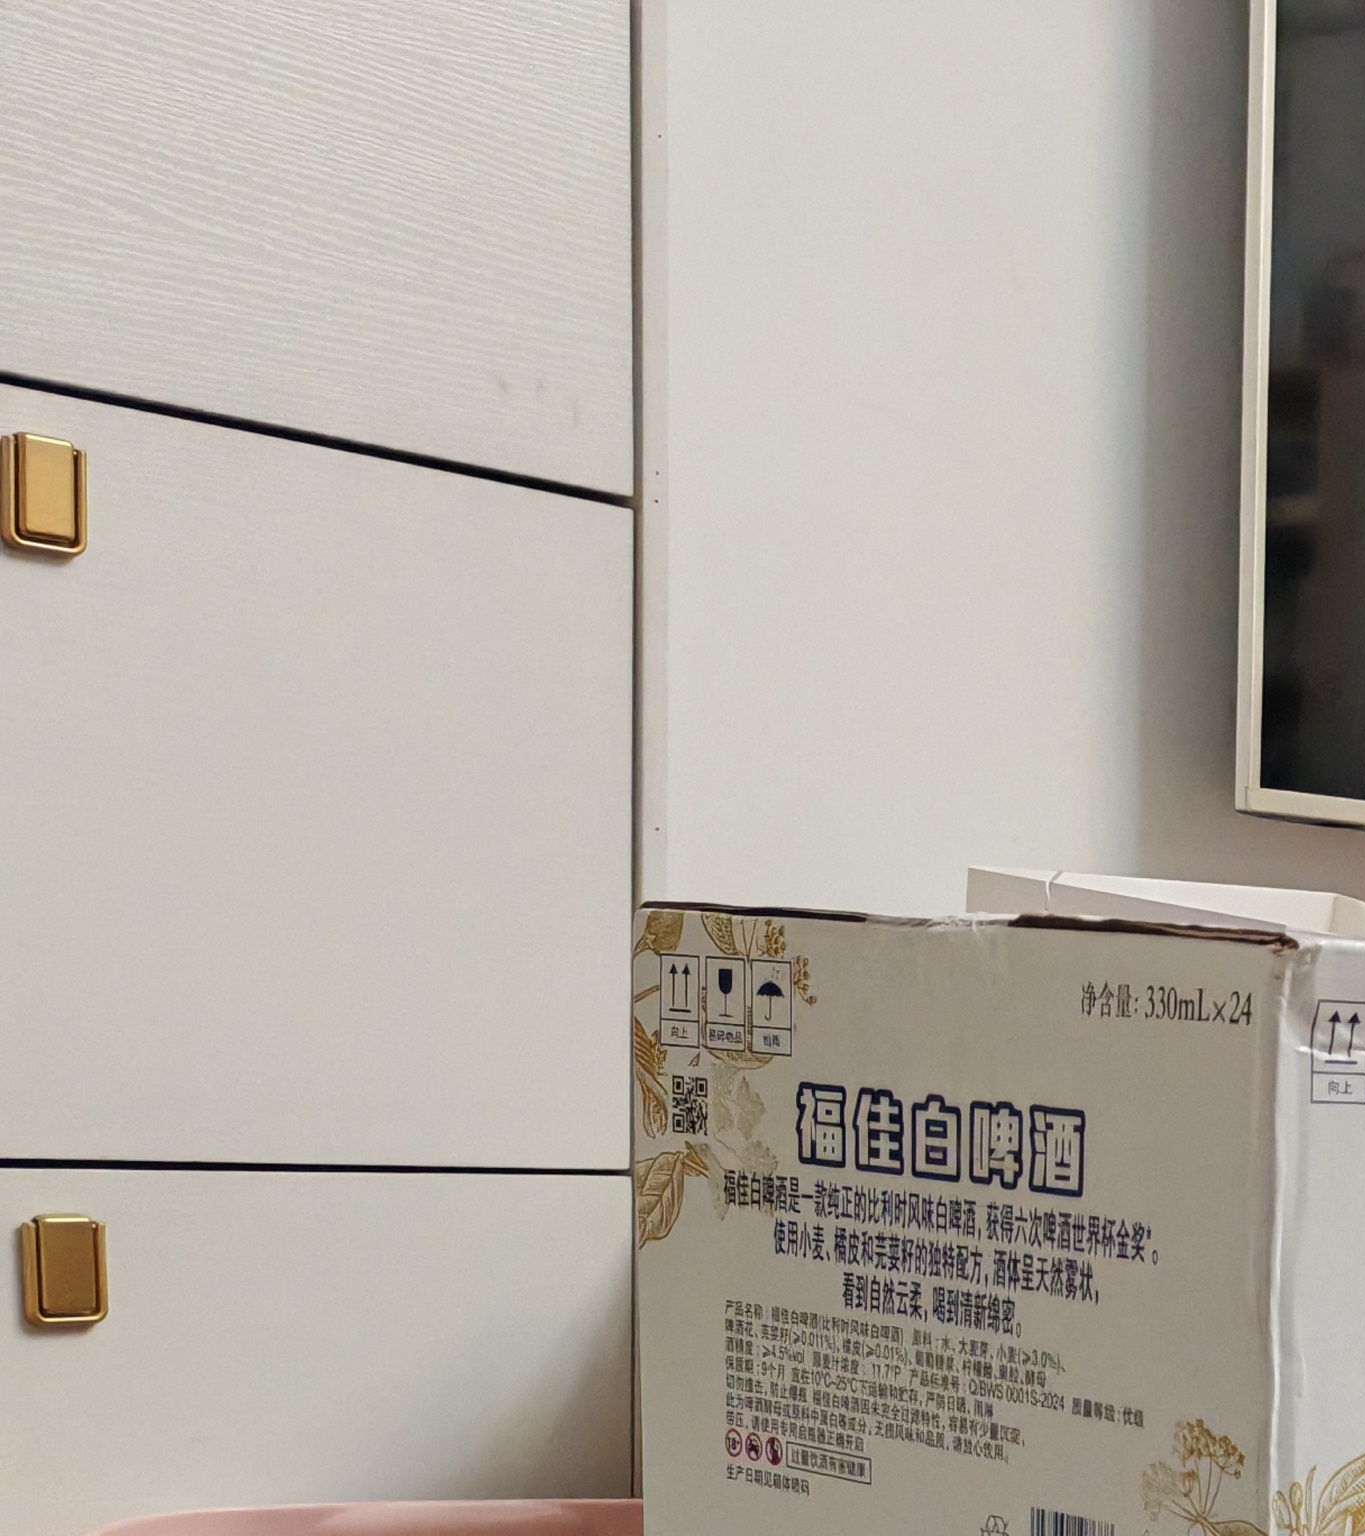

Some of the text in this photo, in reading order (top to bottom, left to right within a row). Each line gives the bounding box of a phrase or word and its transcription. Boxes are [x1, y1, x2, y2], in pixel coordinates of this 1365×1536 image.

[1327, 1080, 1353, 1096] 向上
[797, 1082, 1085, 1197] 福佳白啤酒
